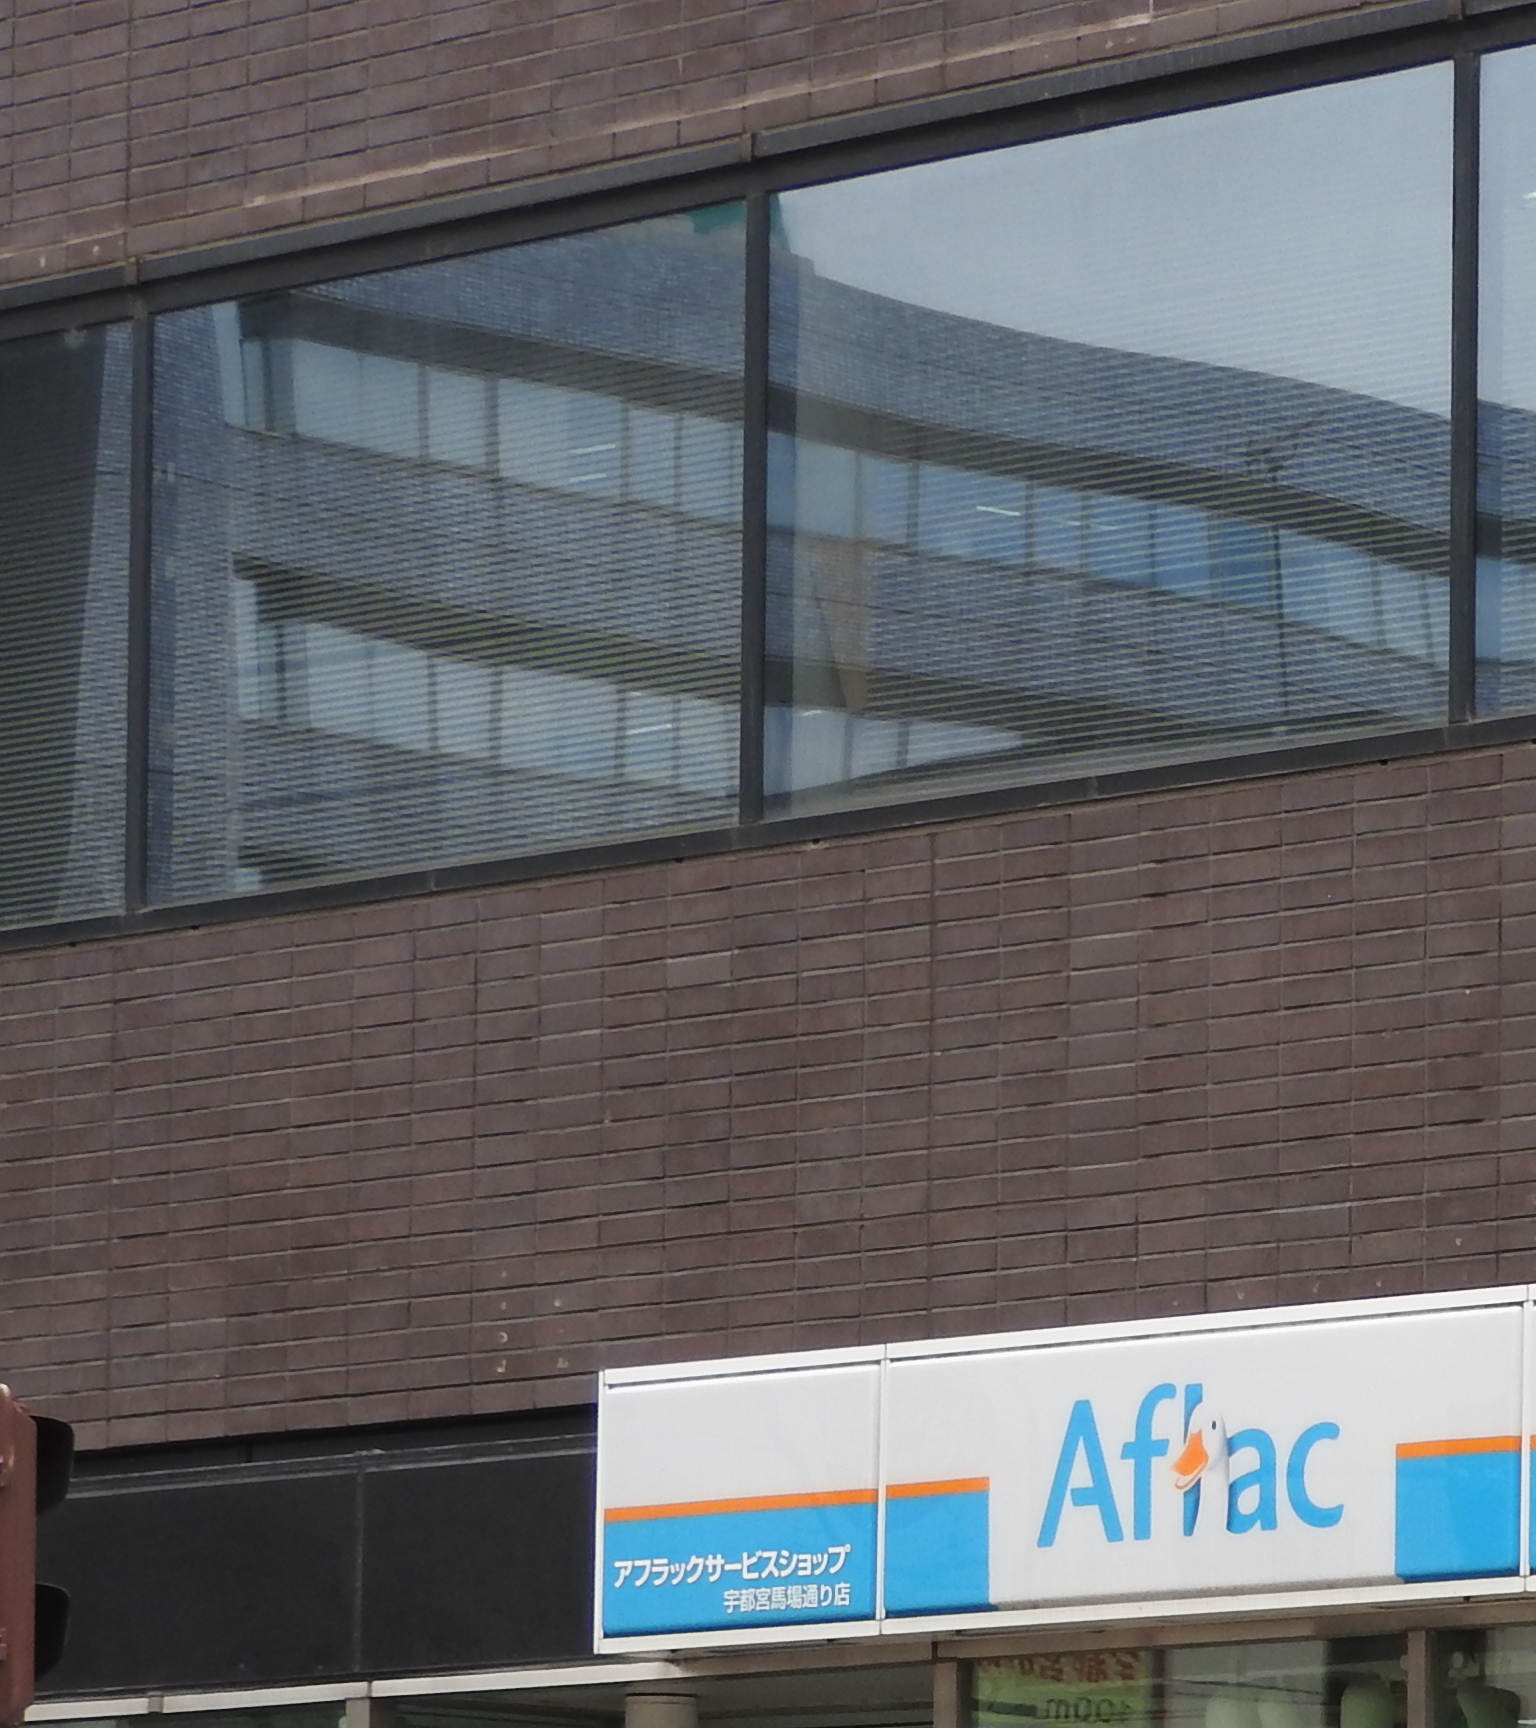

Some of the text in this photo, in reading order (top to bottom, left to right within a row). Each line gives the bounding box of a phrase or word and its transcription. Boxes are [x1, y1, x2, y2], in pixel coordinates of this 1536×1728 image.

[1036, 1382, 1345, 1548] Aflac
[613, 1543, 852, 1588] アフラックサービスショップ
[722, 1581, 852, 1613] 宇都宮馬場通り店
